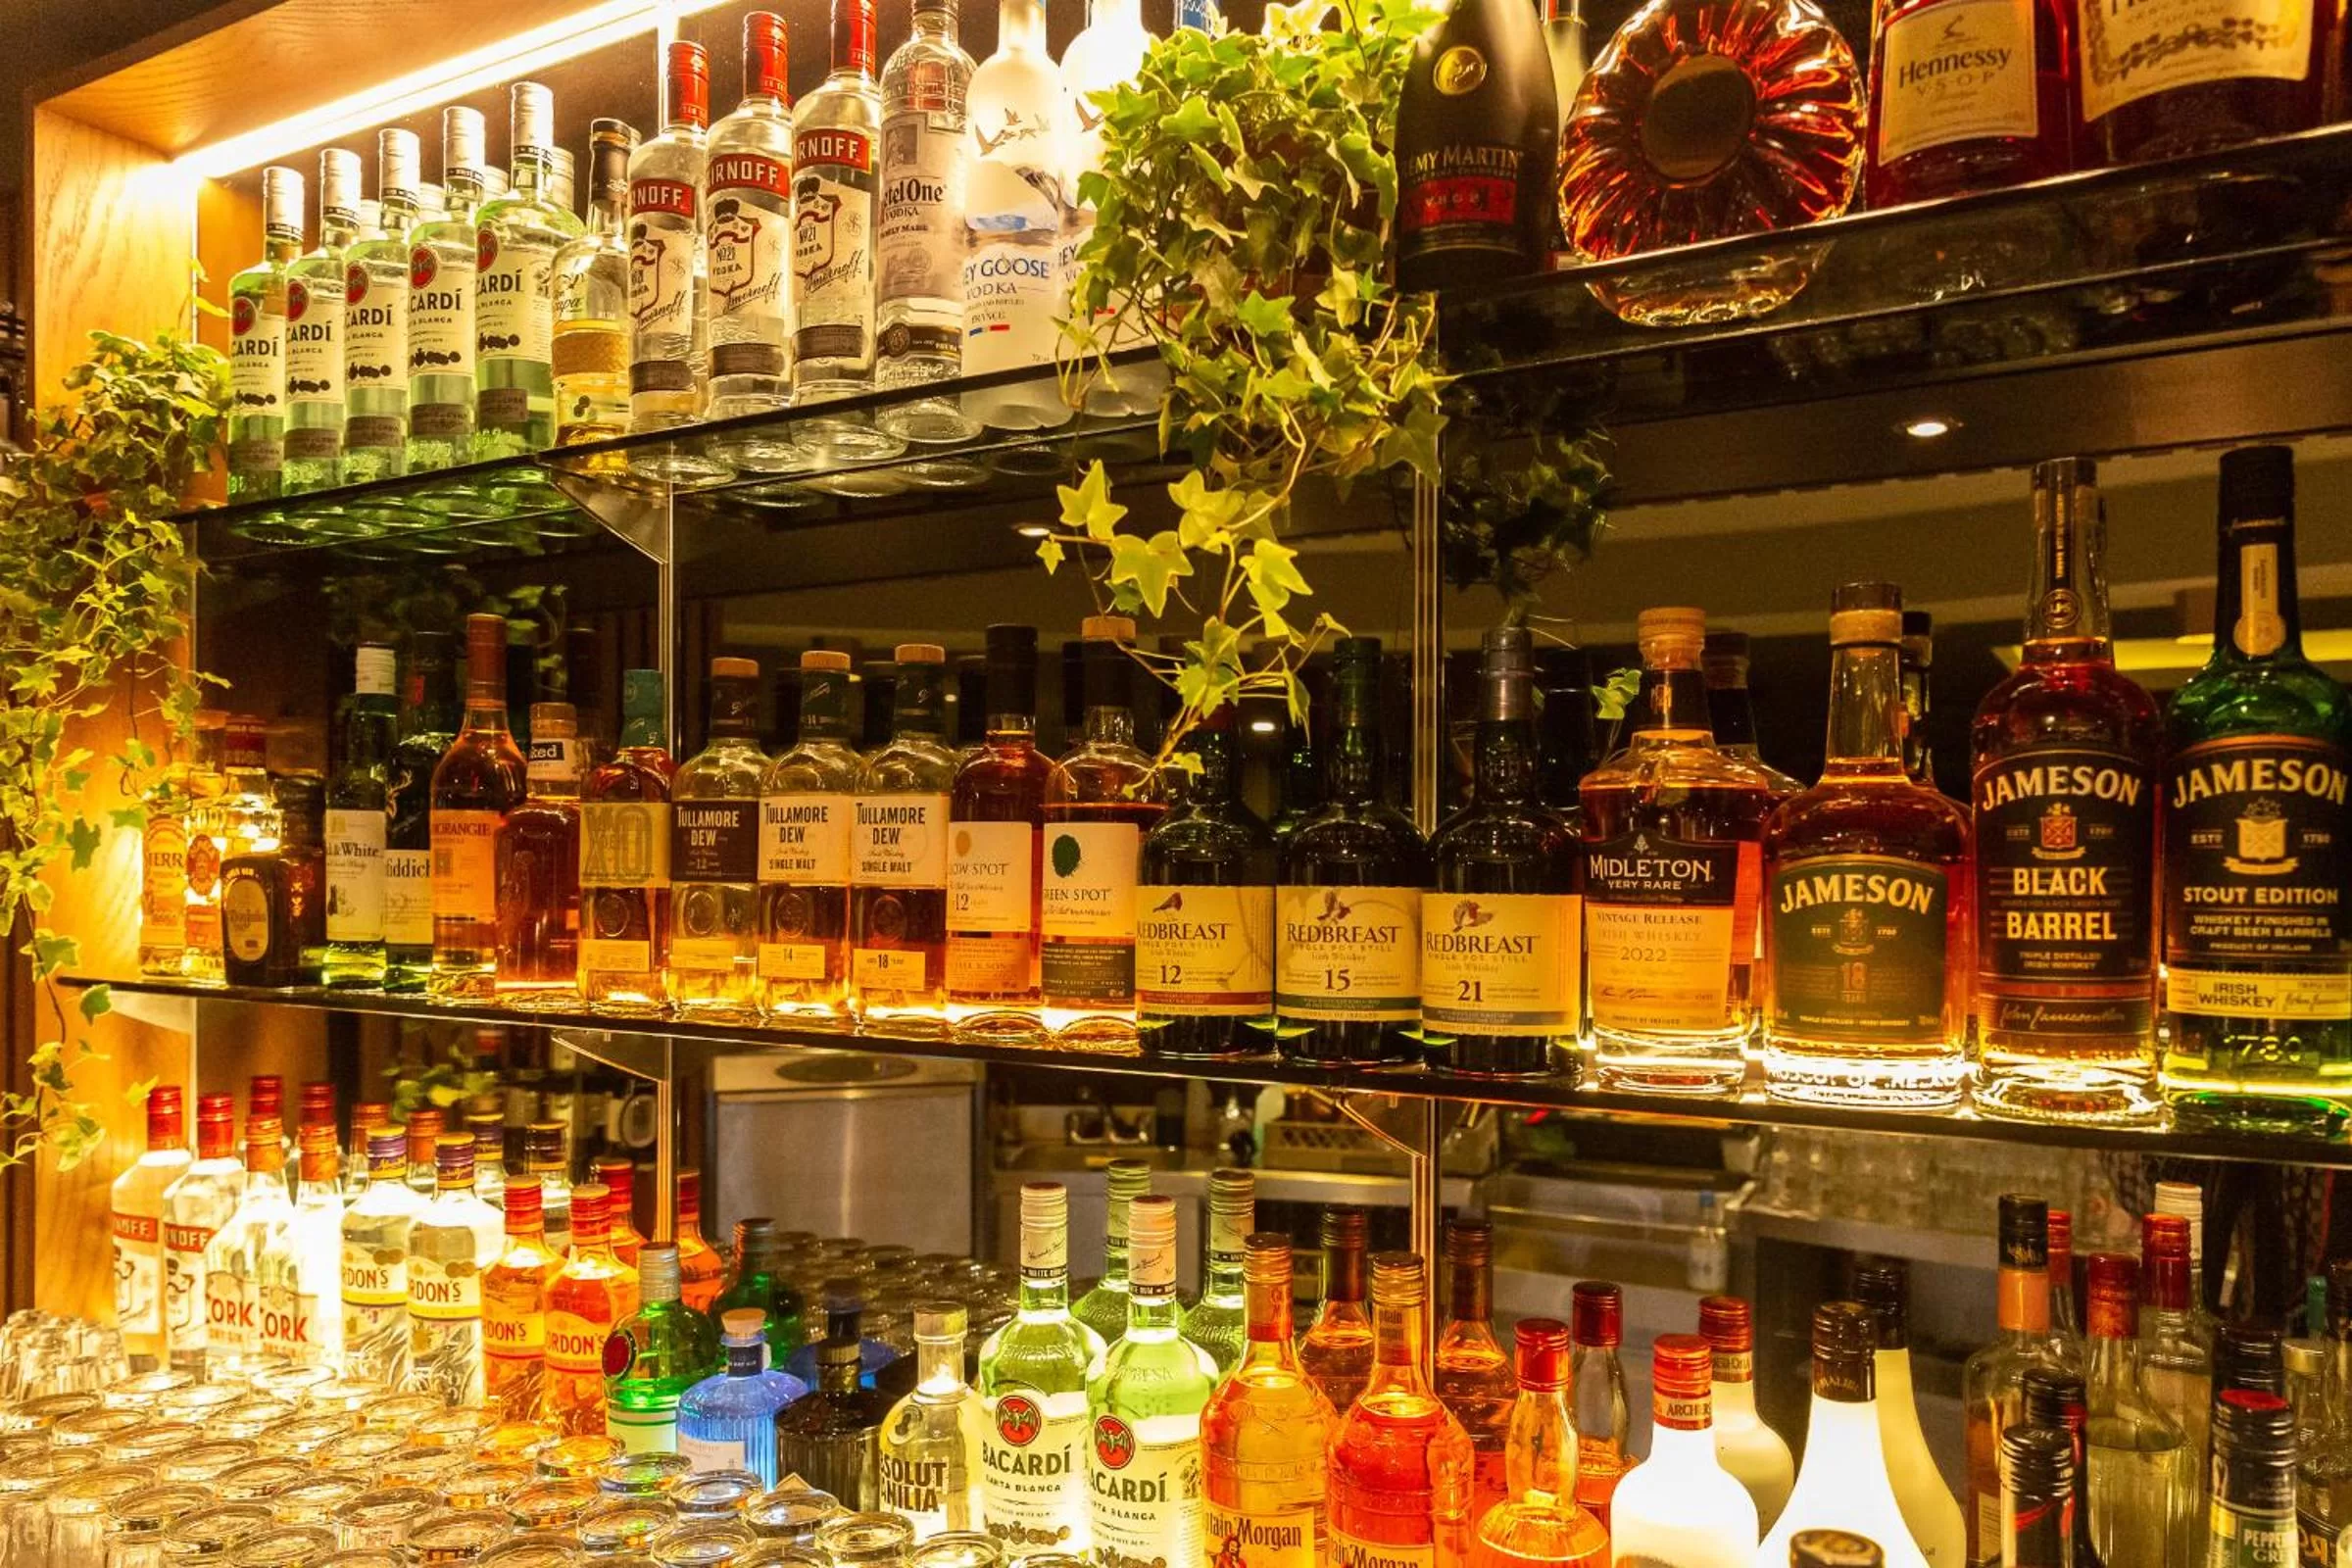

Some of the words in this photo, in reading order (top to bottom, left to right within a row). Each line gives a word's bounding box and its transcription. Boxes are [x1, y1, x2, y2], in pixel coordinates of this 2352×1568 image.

[1899, 48, 2011, 88] Hennessy
[906, 178, 944, 203] One
[981, 257, 1050, 279] GOOSE
[1983, 765, 2141, 810] JAMESON
[2173, 759, 2349, 808] JAMESON
[677, 806, 740, 827] TULLAMORE
[764, 803, 828, 825] TULLAMORE
[856, 803, 926, 825] TULLAMORE
[691, 829, 717, 847] DEW
[779, 827, 806, 843] DEW
[872, 827, 902, 845] DEW
[796, 858, 816, 870] MALT
[890, 861, 912, 873] MALT
[972, 862, 1010, 876] SPOT
[1590, 855, 1712, 882] MIDLETON
[1608, 880, 1639, 890] VERY
[1643, 880, 1682, 891] RARE
[2013, 867, 2108, 896] BLACK
[955, 893, 969, 911] 12
[1074, 888, 1112, 902] SPOT
[1781, 873, 1935, 914] JAMESON
[2183, 886, 2248, 904] STOUT
[2255, 887, 2339, 905] EDITION
[1596, 912, 1640, 924] VINTAGE
[1643, 912, 1702, 926] RELEASE
[2007, 911, 2118, 940] BARREL
[2193, 914, 2251, 924] WHISKEY
[1287, 923, 1403, 943] REDBREAST
[2189, 925, 2230, 935] CRAFT
[2233, 926, 2271, 937] BEER
[1426, 932, 1541, 955] REDBREAST
[877, 954, 888, 969] 18
[1620, 947, 1667, 961] 2022
[1160, 964, 1182, 984] 12
[1324, 968, 1350, 991] 15
[1457, 980, 1483, 1002] 21
[2213, 982, 2258, 995] IRISH
[2198, 994, 2277, 1007] WHISKEY
[260, 1309, 309, 1344] ORK
[983, 1440, 1072, 1477] BACARDÍ
[881, 1452, 948, 1488] SOLUT
[1015, 1483, 1061, 1493] BLANCA
[1111, 1507, 1156, 1521] BLANCA
[1234, 1517, 1301, 1551] Morgan
